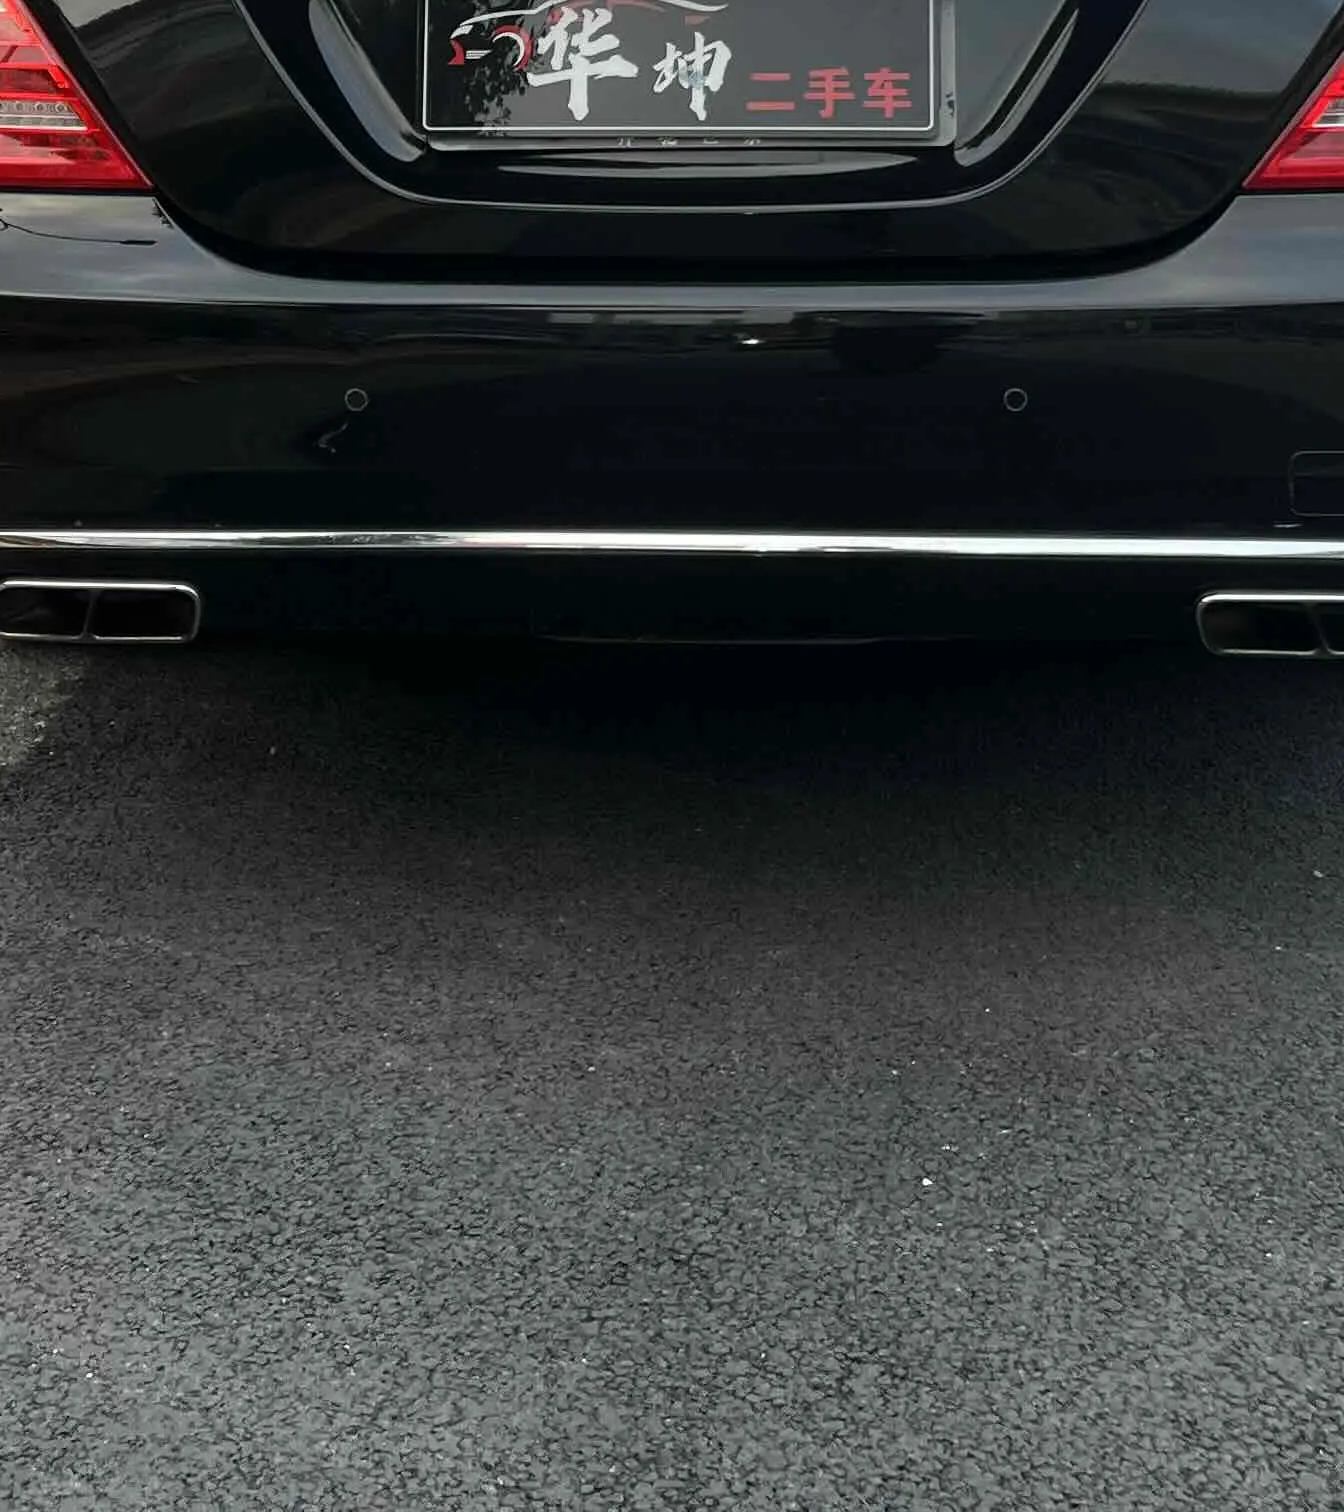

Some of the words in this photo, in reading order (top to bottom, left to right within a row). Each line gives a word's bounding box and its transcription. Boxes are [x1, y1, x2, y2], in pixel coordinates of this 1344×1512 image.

[526, 5, 733, 121] 华坤
[746, 67, 913, 119] 二手车
